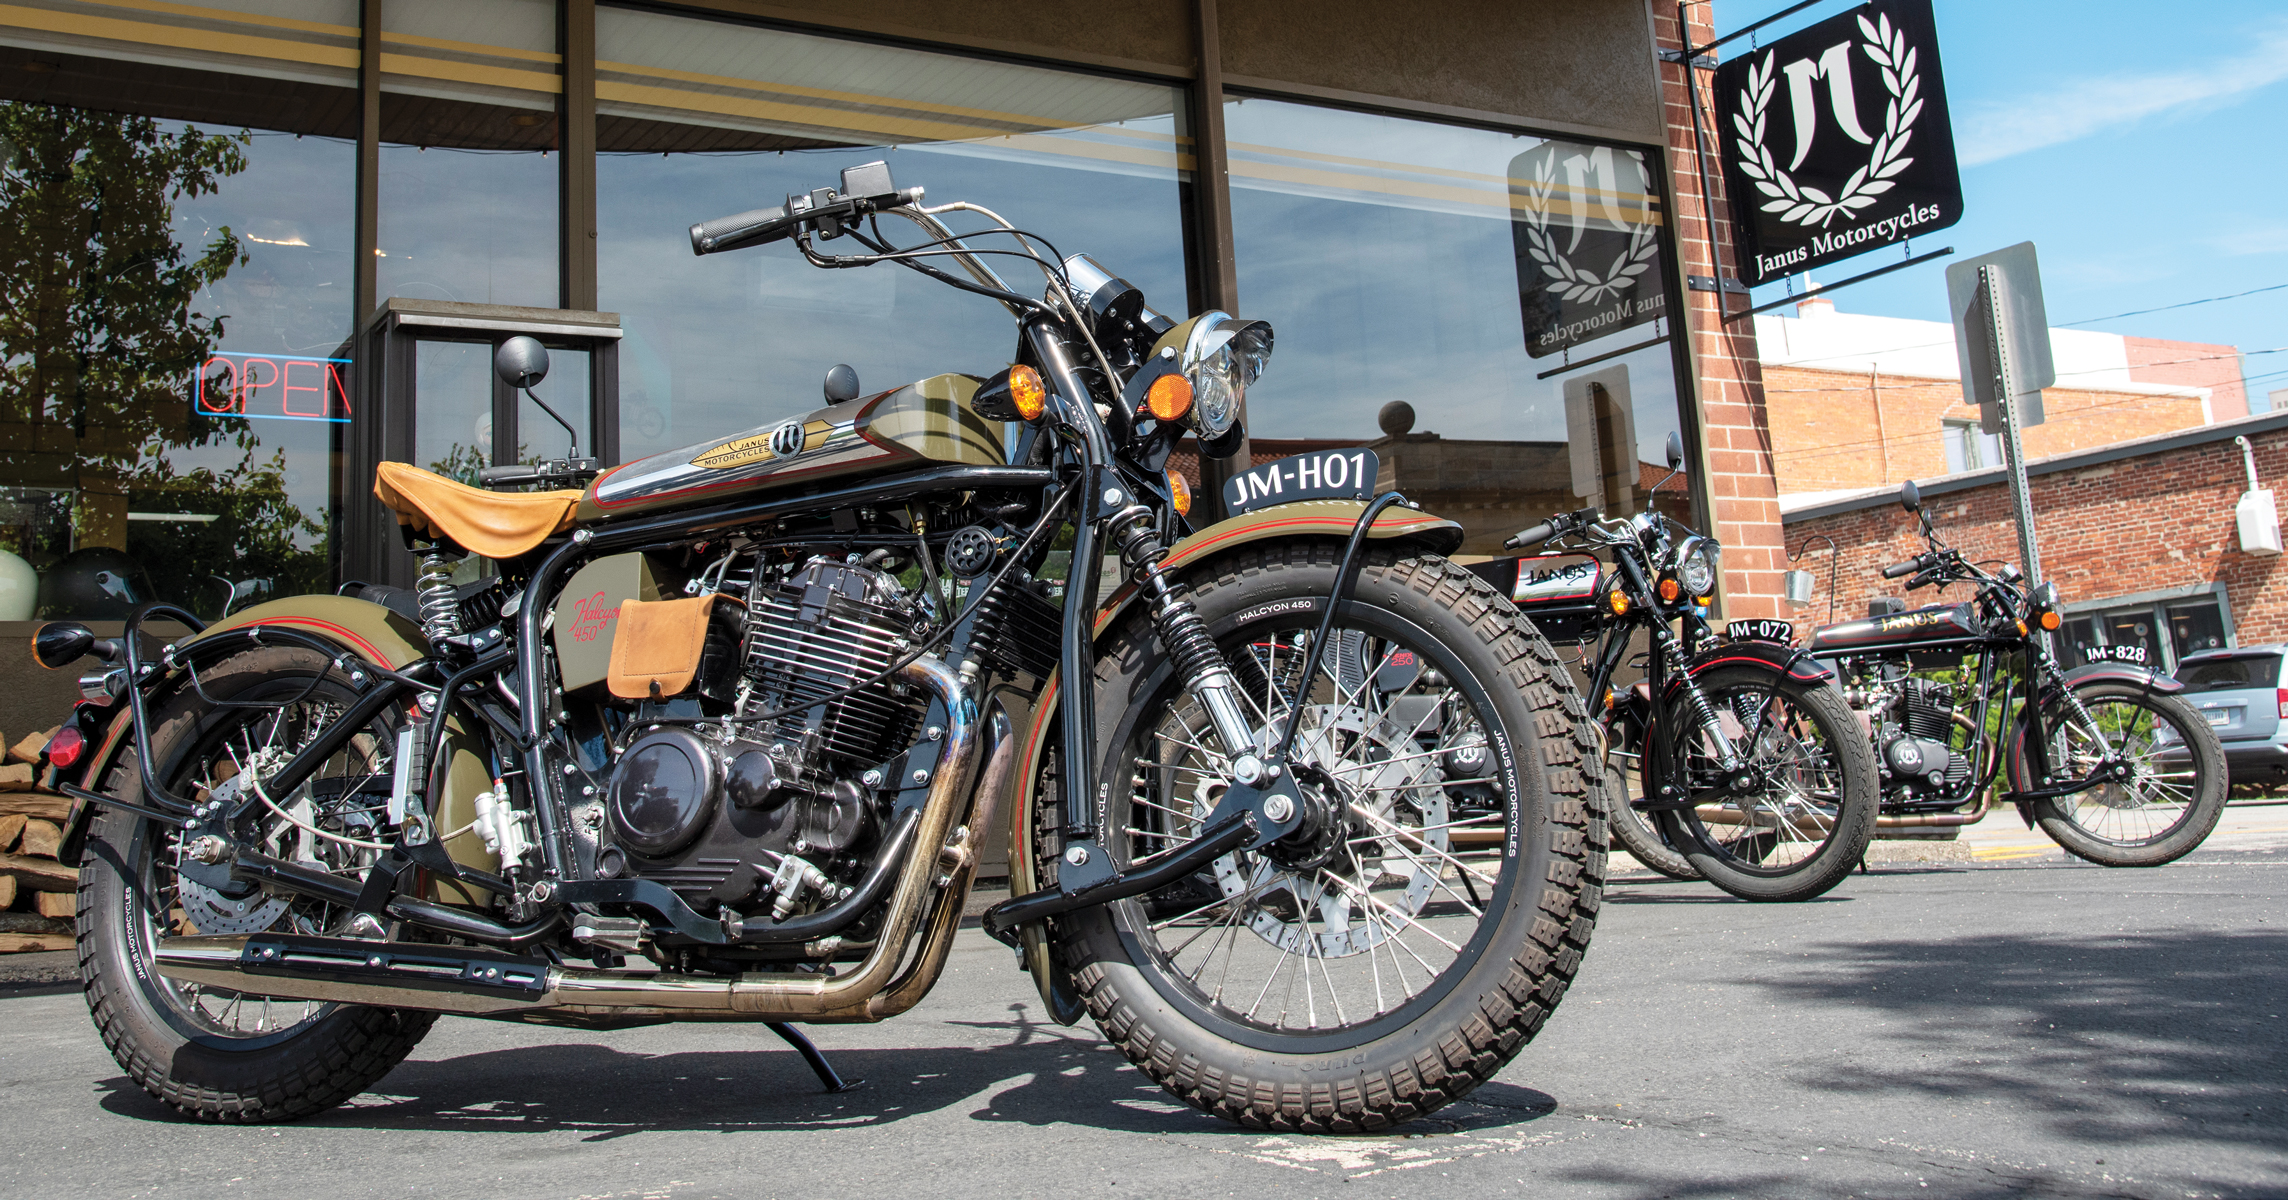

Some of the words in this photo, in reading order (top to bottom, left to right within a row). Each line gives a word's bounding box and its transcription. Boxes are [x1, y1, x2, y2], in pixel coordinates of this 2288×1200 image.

[1754, 245, 1808, 280] Janus
[1811, 203, 1941, 257] Motorcycles
[200, 356, 353, 418] OPEN
[738, 437, 770, 450] JANUS
[704, 446, 771, 467] MOTORCYCLES
[1232, 452, 1365, 506] JM-H01
[1239, 602, 1290, 622] HALCYON
[1291, 600, 1312, 609] 450
[1881, 611, 1939, 632] JANUS
[573, 625, 598, 642] 450
[1728, 620, 1791, 642] JM-072
[1390, 658, 1414, 667] 250
[2086, 645, 2147, 662] JM-828
[1493, 729, 1512, 768] JANUS
[1505, 768, 1519, 858] MOTORCYCLES
[124, 886, 137, 953] MOTORCYCLES
[132, 952, 147, 980] JANUS
